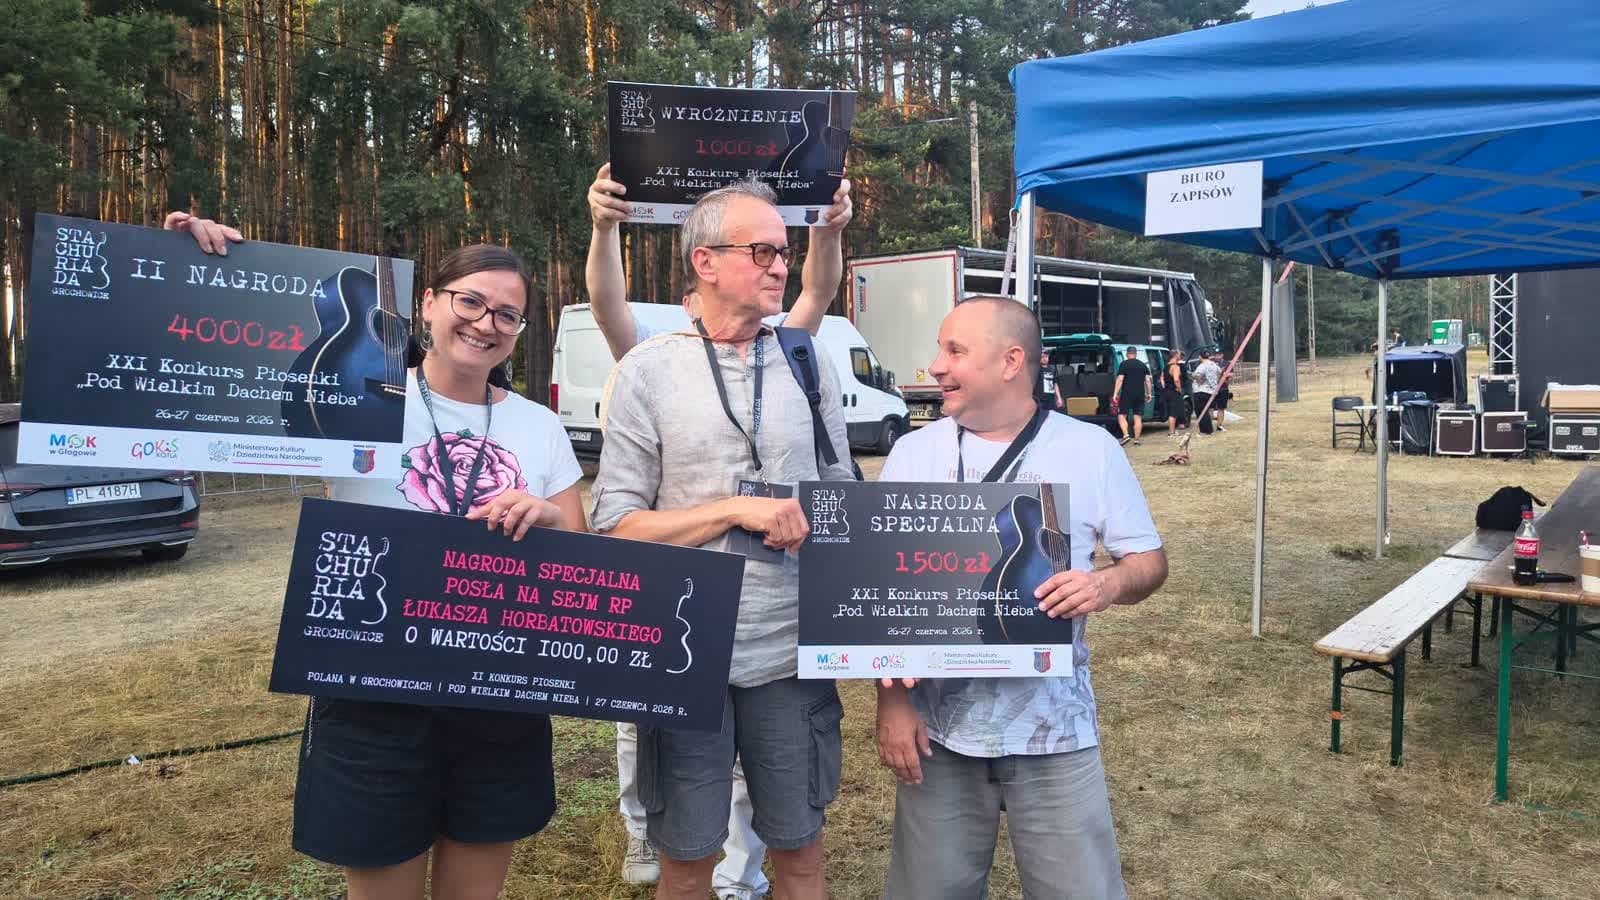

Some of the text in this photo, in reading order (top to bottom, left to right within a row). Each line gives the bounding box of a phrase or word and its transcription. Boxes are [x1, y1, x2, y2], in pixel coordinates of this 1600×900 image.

[620, 99, 644, 109] CHU
[621, 108, 645, 118] RIA
[621, 116, 638, 126] DA
[661, 106, 802, 124] WYRÓŻNIENIE
[656, 166, 681, 176] XXI
[687, 168, 740, 178] Konkurs
[1181, 169, 1225, 185] BIURO
[1170, 185, 1235, 203] ZAPISÓW
[56, 227, 95, 244] STA
[55, 242, 95, 258] CHU
[54, 256, 94, 273] RIA
[52, 270, 80, 286] DA
[131, 258, 327, 298] II NAGRODA
[51, 287, 110, 300] GROCHOWICE
[106, 354, 341, 386] XXI Konkurs Piosenki
[134, 376, 215, 396] Wielkim
[227, 384, 293, 402] Dachem
[155, 409, 290, 428] 26-27 czerwca 2026 r.
[233, 443, 306, 454] Ministerstwo Kultury
[236, 451, 278, 459] Dziedzictwa
[279, 453, 323, 462] Narodowego
[75, 484, 138, 500] PL 4187H
[811, 490, 838, 501] STA
[811, 500, 838, 512] CHU
[883, 494, 986, 511] NAGRODA
[812, 512, 838, 524] RIA
[870, 516, 1000, 534] SPECJALNA
[813, 524, 831, 535] DA
[319, 531, 372, 556] STA
[316, 553, 372, 577] CHU
[443, 550, 641, 591] NAGRODA SPECJALNA
[895, 551, 959, 575] 1500
[311, 575, 365, 600] RIA
[444, 576, 632, 615] POSŁA NA SEJM RP
[851, 588, 1020, 601] XXI Konkurs Piosenki
[306, 597, 345, 620] DA
[871, 604, 929, 617] Wielkim
[936, 604, 986, 617] Dachem
[403, 599, 662, 644] ŁUKASZA HORBATOWSKIEGO
[304, 626, 384, 643] GROCHOWICE
[887, 627, 911, 636] 26-27
[915, 628, 948, 636] czerwca
[952, 627, 973, 635] 2026
[405, 626, 418, 643] O
[431, 628, 528, 655] WARTOŚCI
[629, 650, 652, 668] ZŁ
[488, 673, 528, 685] KONKURS
[532, 677, 576, 690] PIOSENKI
[307, 671, 344, 684] POLANA
[349, 675, 356, 683] W
[361, 676, 432, 691] GROCHOWICACH
[448, 684, 466, 694] POD
[471, 685, 511, 697] WIELKIM
[515, 689, 548, 701] DACHEM
[553, 694, 580, 705] NIEBA
[595, 698, 607, 707] 27
[611, 700, 648, 712] CZERWCA
[652, 704, 673, 715] 2026
[678, 707, 688, 717] R.
